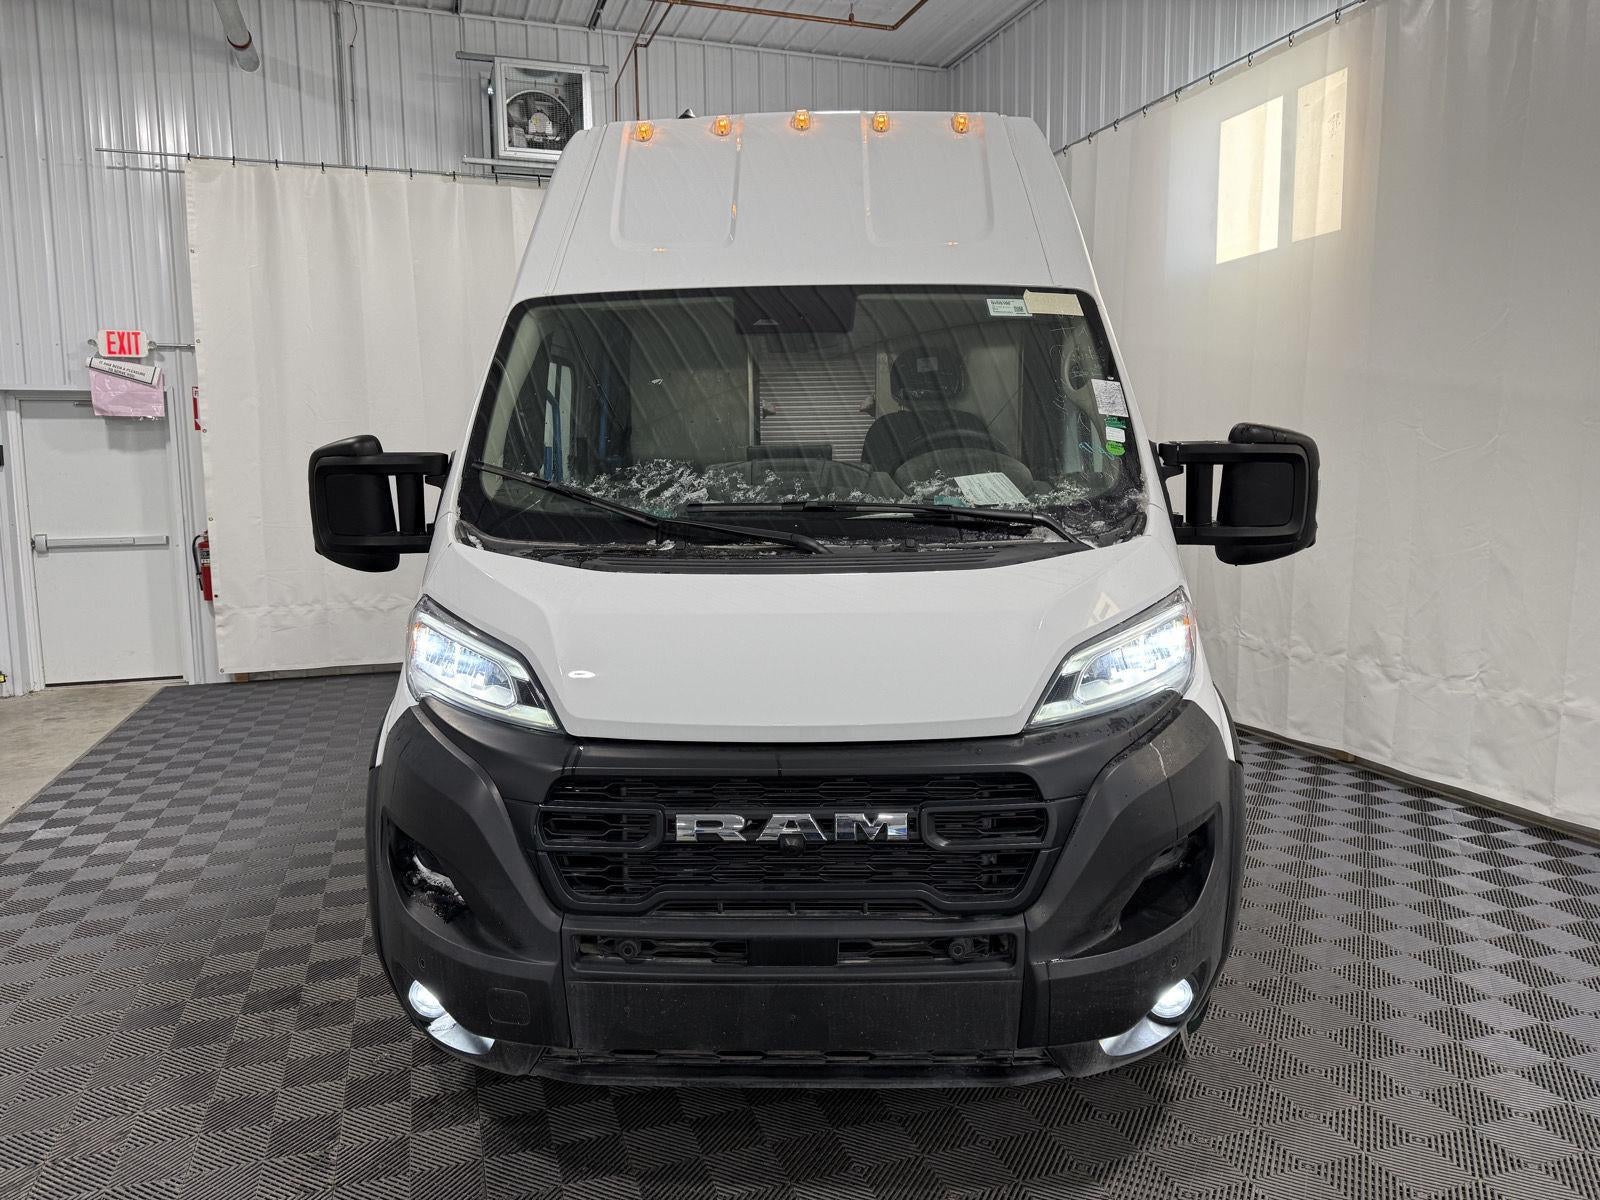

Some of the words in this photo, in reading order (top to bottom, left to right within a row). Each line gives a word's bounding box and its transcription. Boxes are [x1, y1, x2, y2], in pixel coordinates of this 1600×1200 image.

[106, 331, 141, 356] EXIT
[126, 367, 146, 377] PLEASURE
[675, 812, 909, 842] RAM
